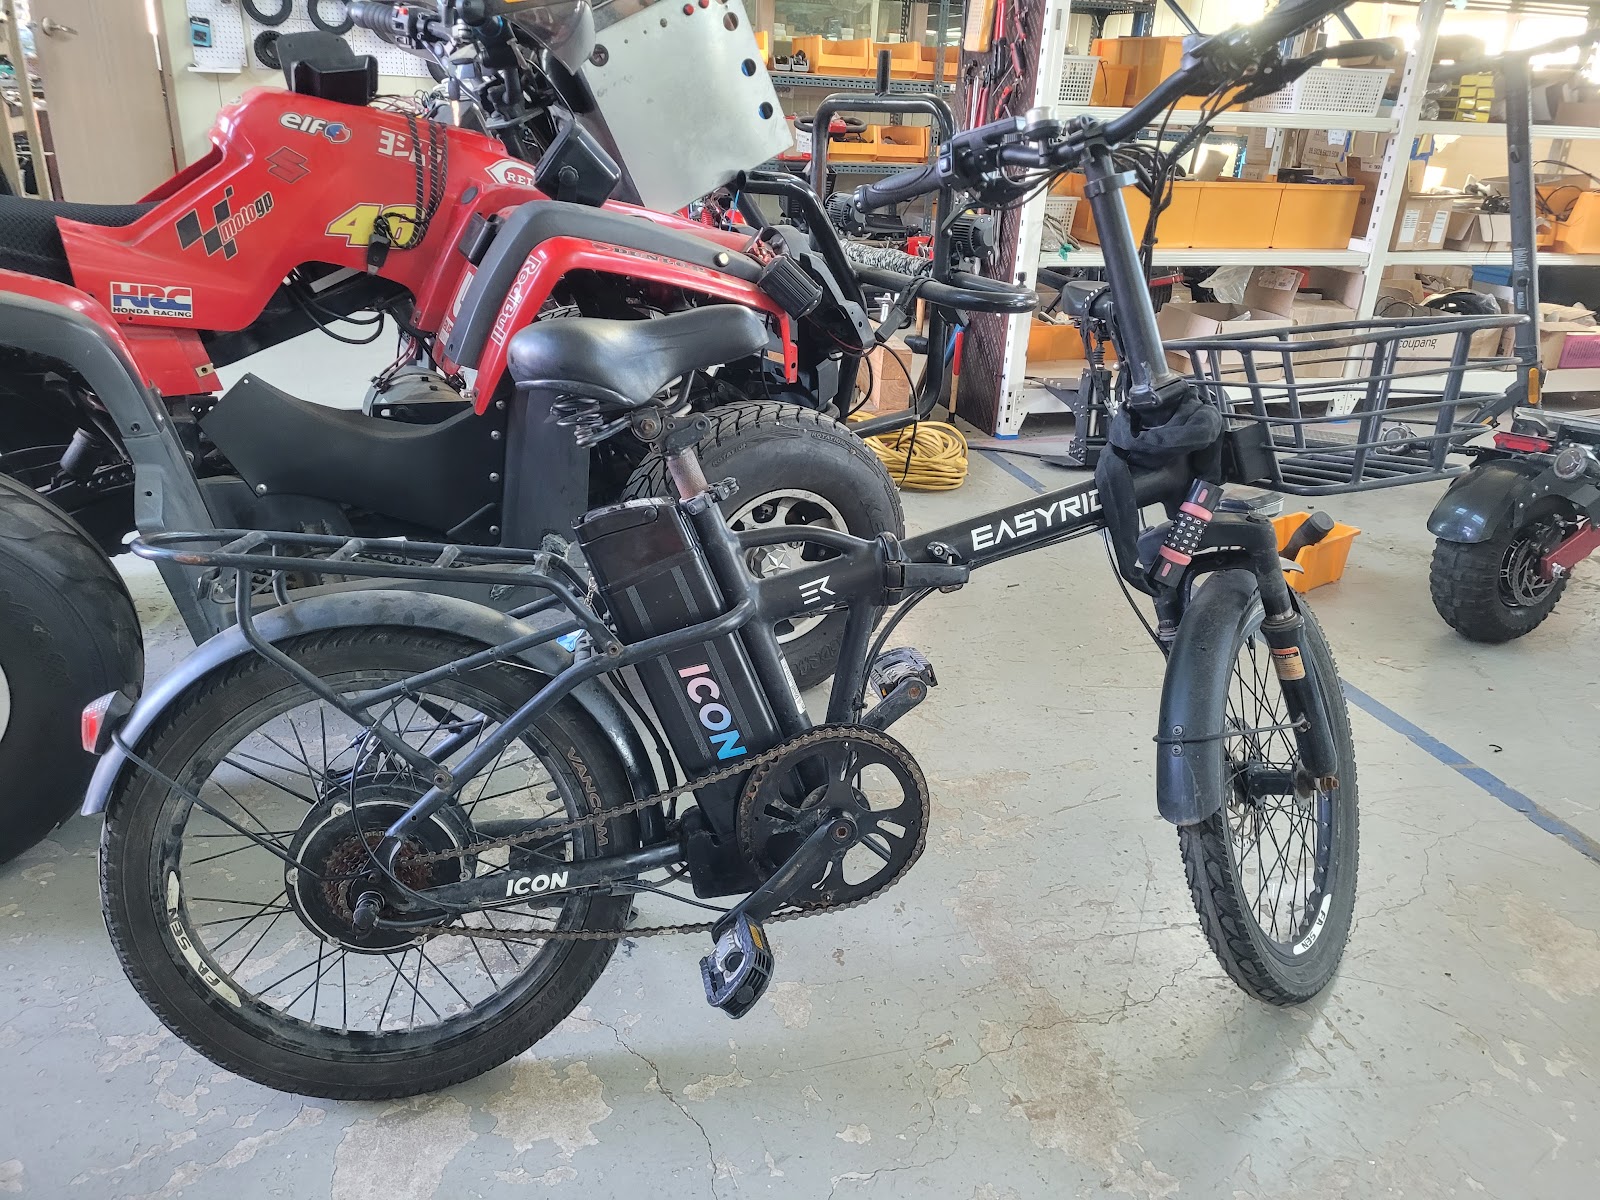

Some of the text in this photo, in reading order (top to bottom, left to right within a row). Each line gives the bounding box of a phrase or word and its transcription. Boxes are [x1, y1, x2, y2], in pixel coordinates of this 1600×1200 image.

[279, 112, 327, 135] elf
[220, 191, 275, 242] motogp
[325, 203, 429, 250] 46
[112, 283, 192, 311] HRC
[113, 306, 192, 318] HONDA RACING
[677, 663, 748, 760] ICON
[505, 870, 569, 897] ICON
